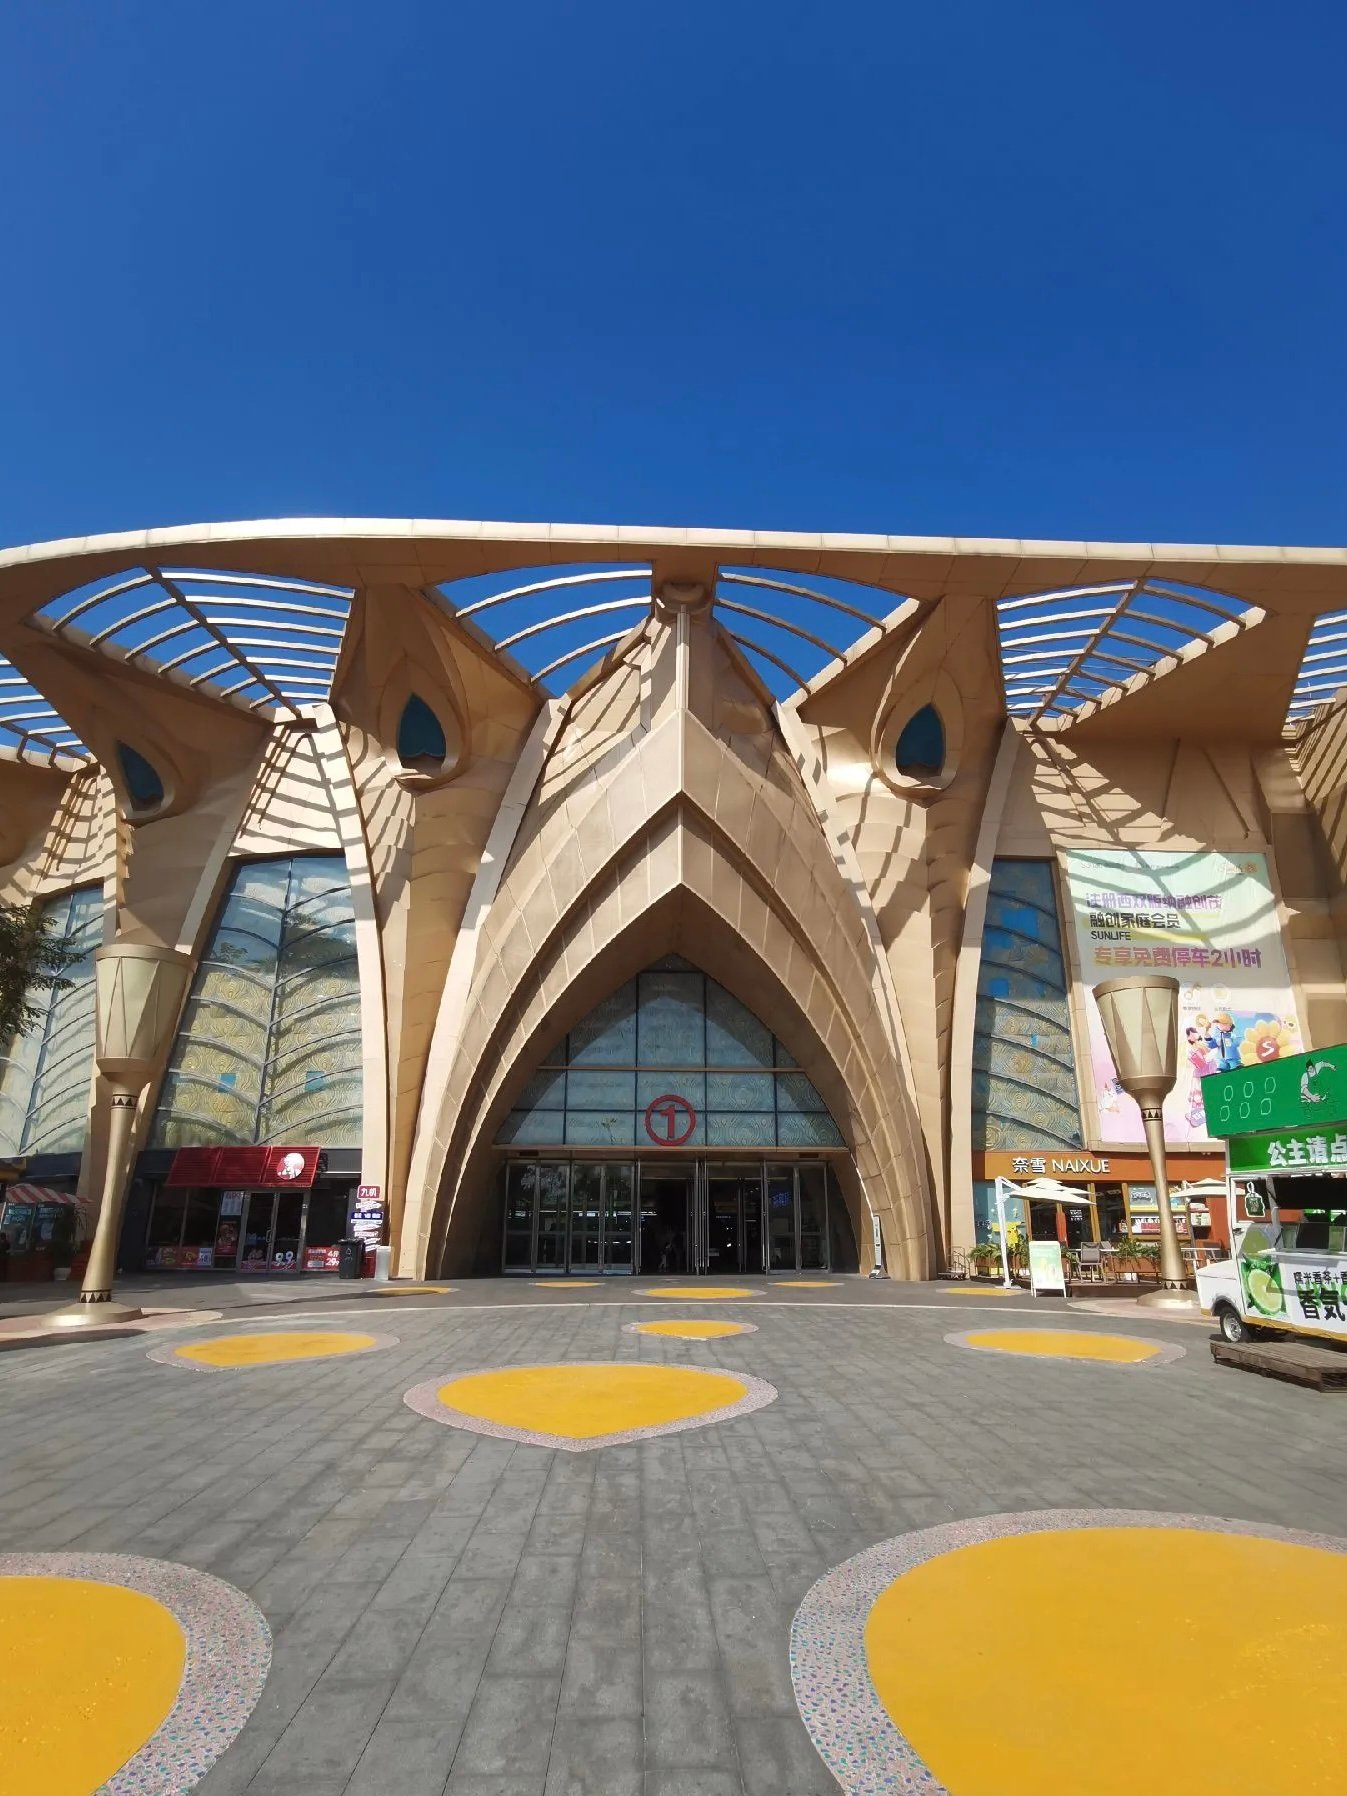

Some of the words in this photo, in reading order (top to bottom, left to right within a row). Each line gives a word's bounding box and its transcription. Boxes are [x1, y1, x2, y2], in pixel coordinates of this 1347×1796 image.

[1089, 912, 1180, 929] 融创家庭会员
[1090, 930, 1132, 941] SUNLIFE
[1094, 946, 1262, 969] 专享免费停车2小时
[1011, 1156, 1046, 1174] 奈雪
[1052, 1159, 1112, 1174] NAIXUE
